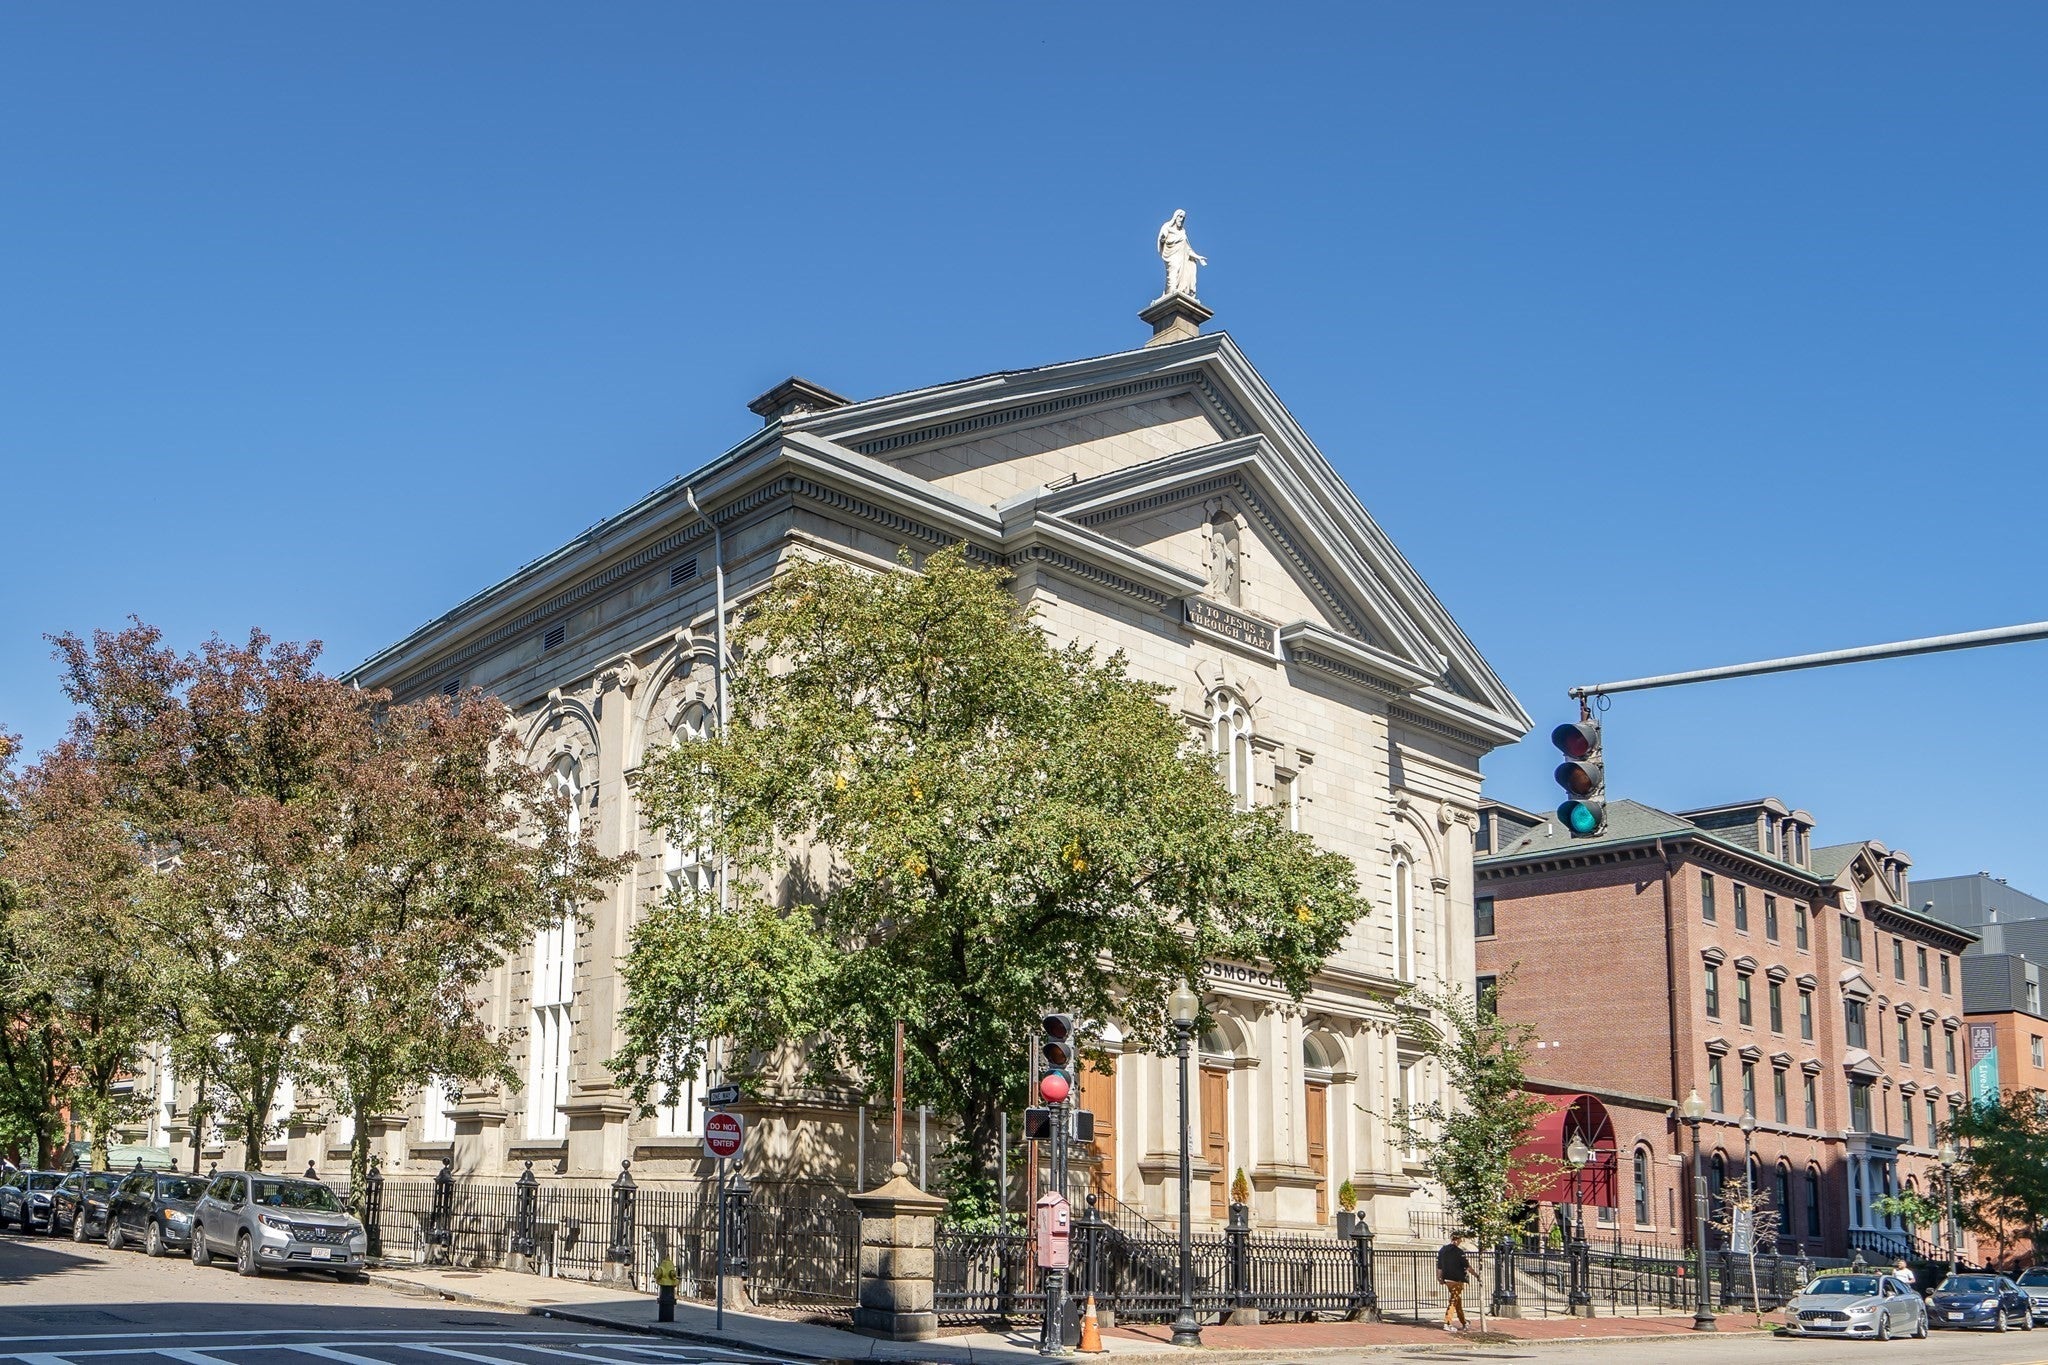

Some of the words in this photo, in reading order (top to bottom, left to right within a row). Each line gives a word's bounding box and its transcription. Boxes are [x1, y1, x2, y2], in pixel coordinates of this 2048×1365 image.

[1190, 611, 1239, 639] THROUGH
[1244, 633, 1272, 650] MARY
[1206, 606, 1219, 619] TO
[1224, 614, 1256, 634] JESUS
[1201, 961, 1283, 989] OSMOPOLI
[712, 1092, 721, 1101] ONE
[722, 1091, 731, 1099] WAY
[723, 1123, 737, 1131] NOT
